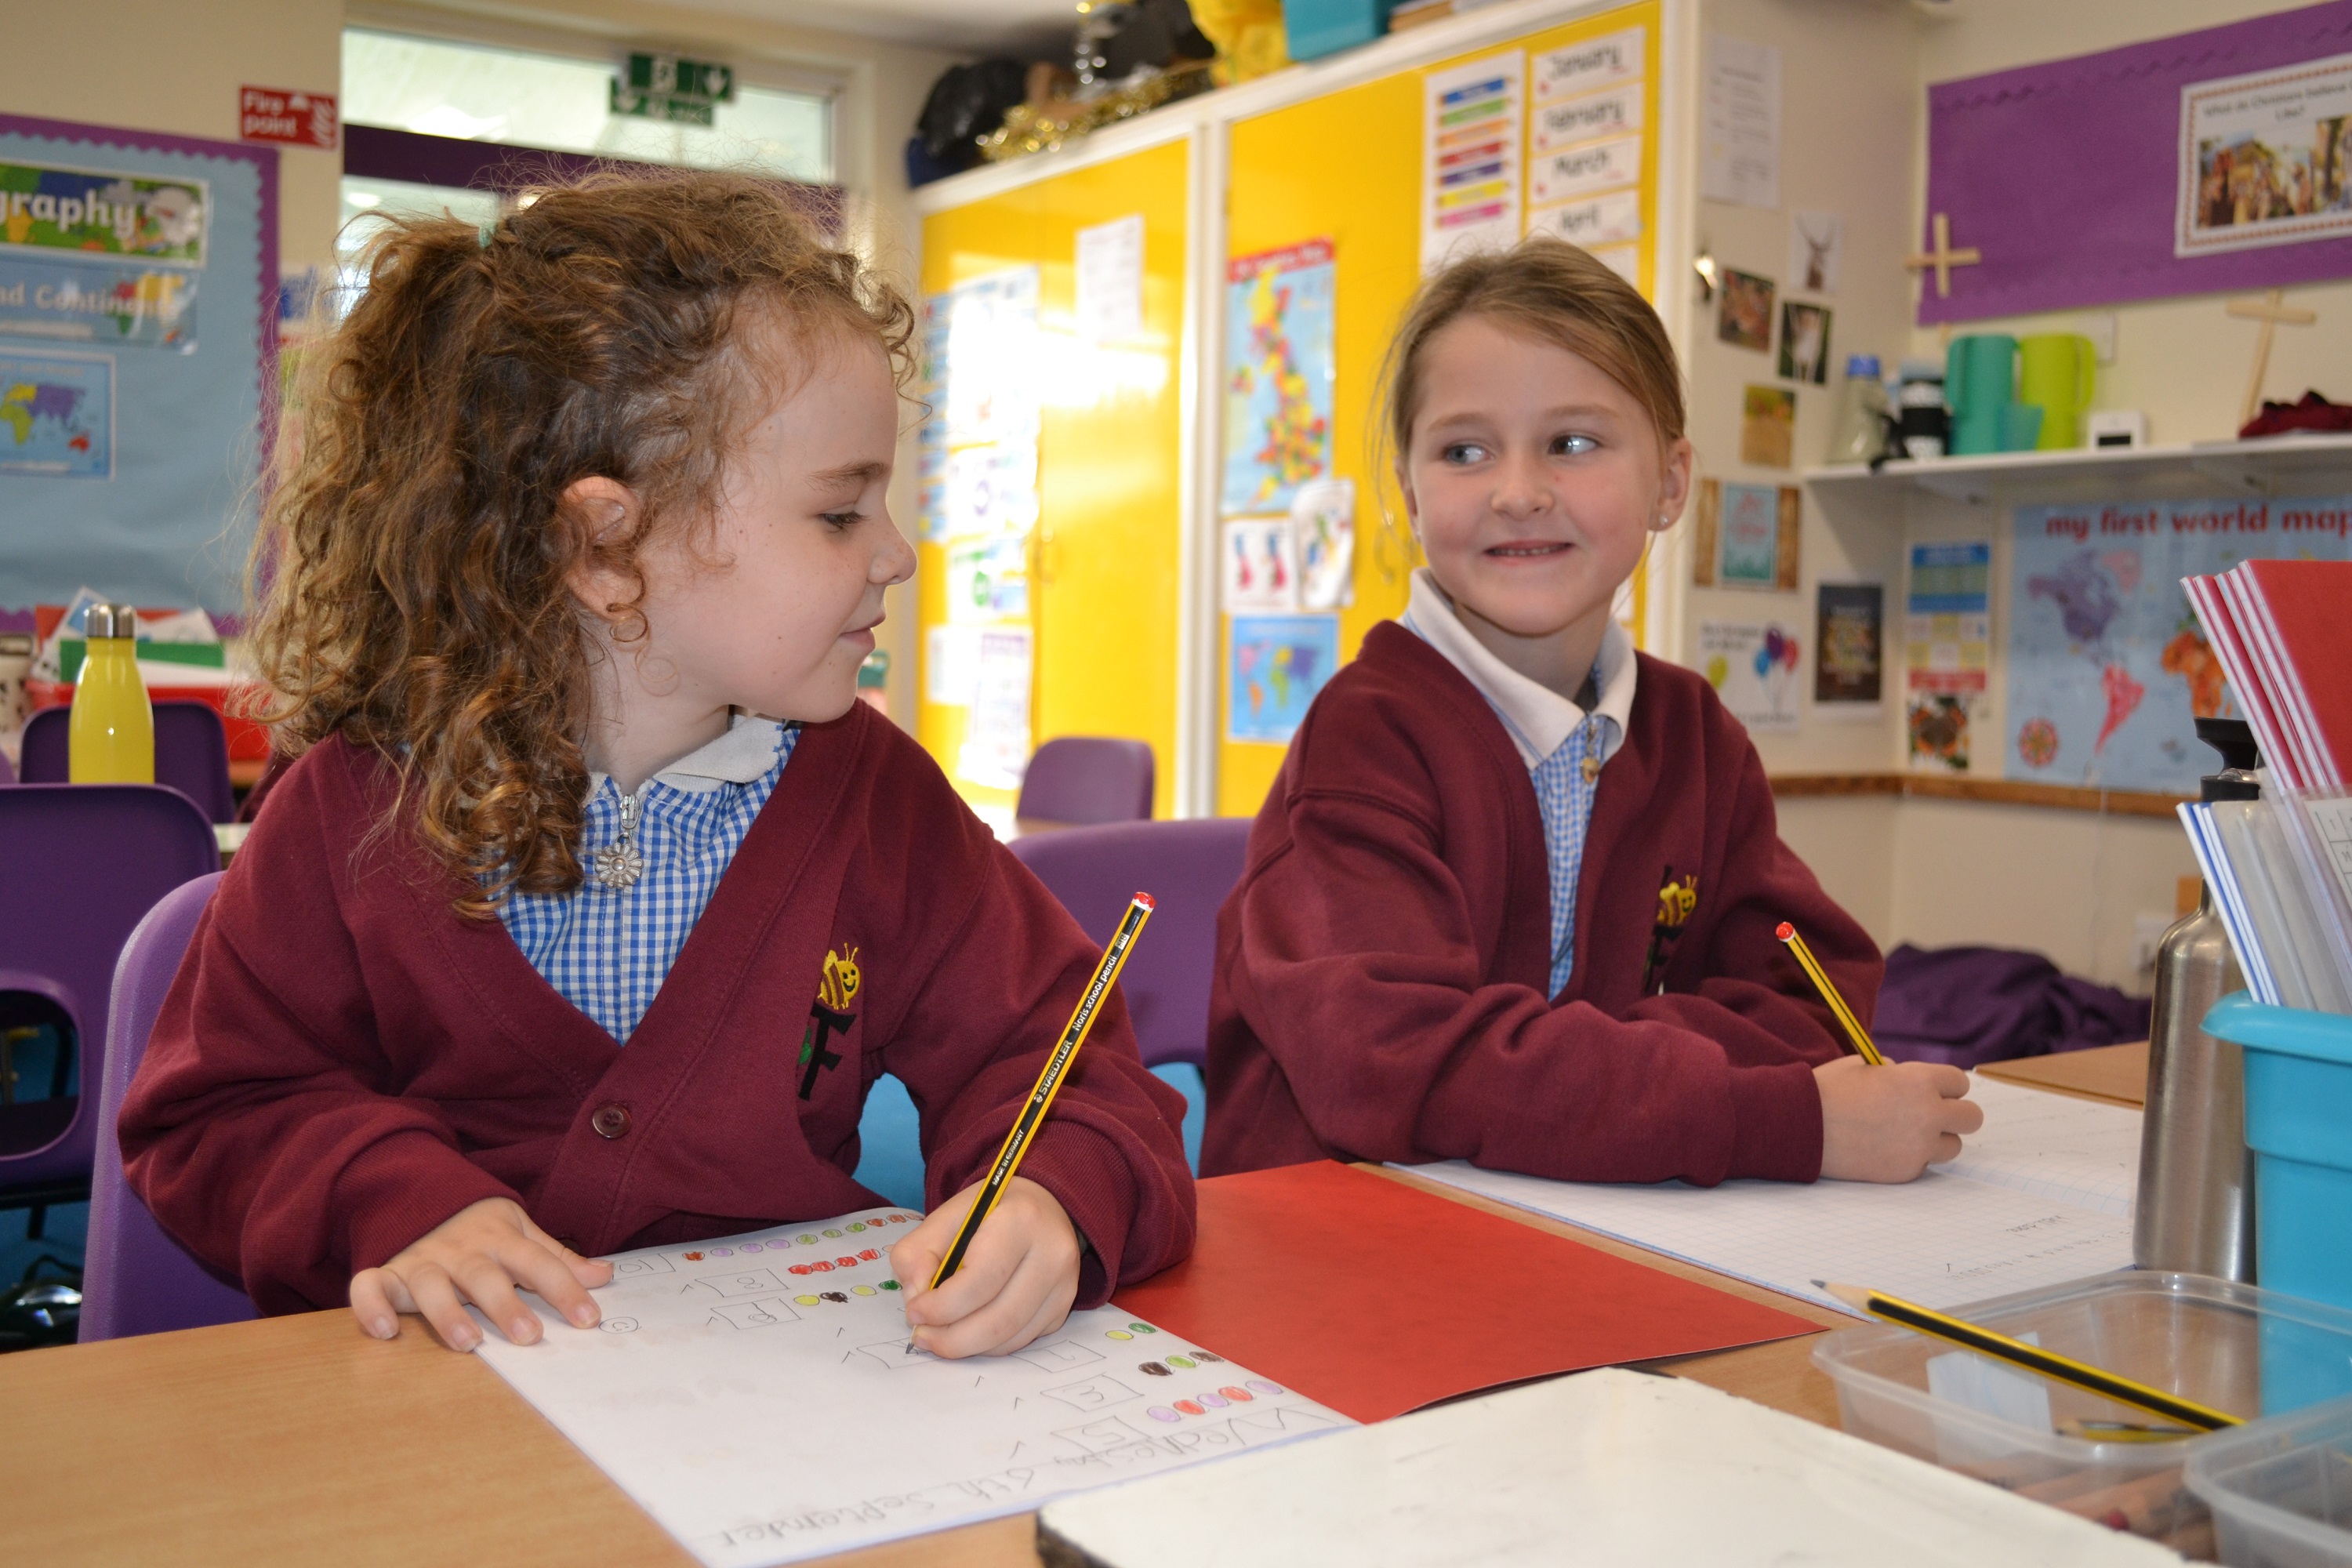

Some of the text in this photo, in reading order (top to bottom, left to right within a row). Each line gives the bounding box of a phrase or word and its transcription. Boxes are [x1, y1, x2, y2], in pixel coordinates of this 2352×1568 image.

[245, 91, 285, 115] Fire
[245, 114, 297, 137] point
[2046, 515, 2089, 543] my
[2100, 507, 2158, 535] first
[2170, 503, 2268, 534] world
[1073, 955, 1117, 1031] Noris school pencil
[1039, 1040, 1073, 1094] STAEDTLER
[1006, 1129, 1025, 1160] GERMANY
[737, 1276, 764, 1290] 8
[1062, 1385, 1105, 1403] 3
[1081, 1425, 1127, 1446] 5
